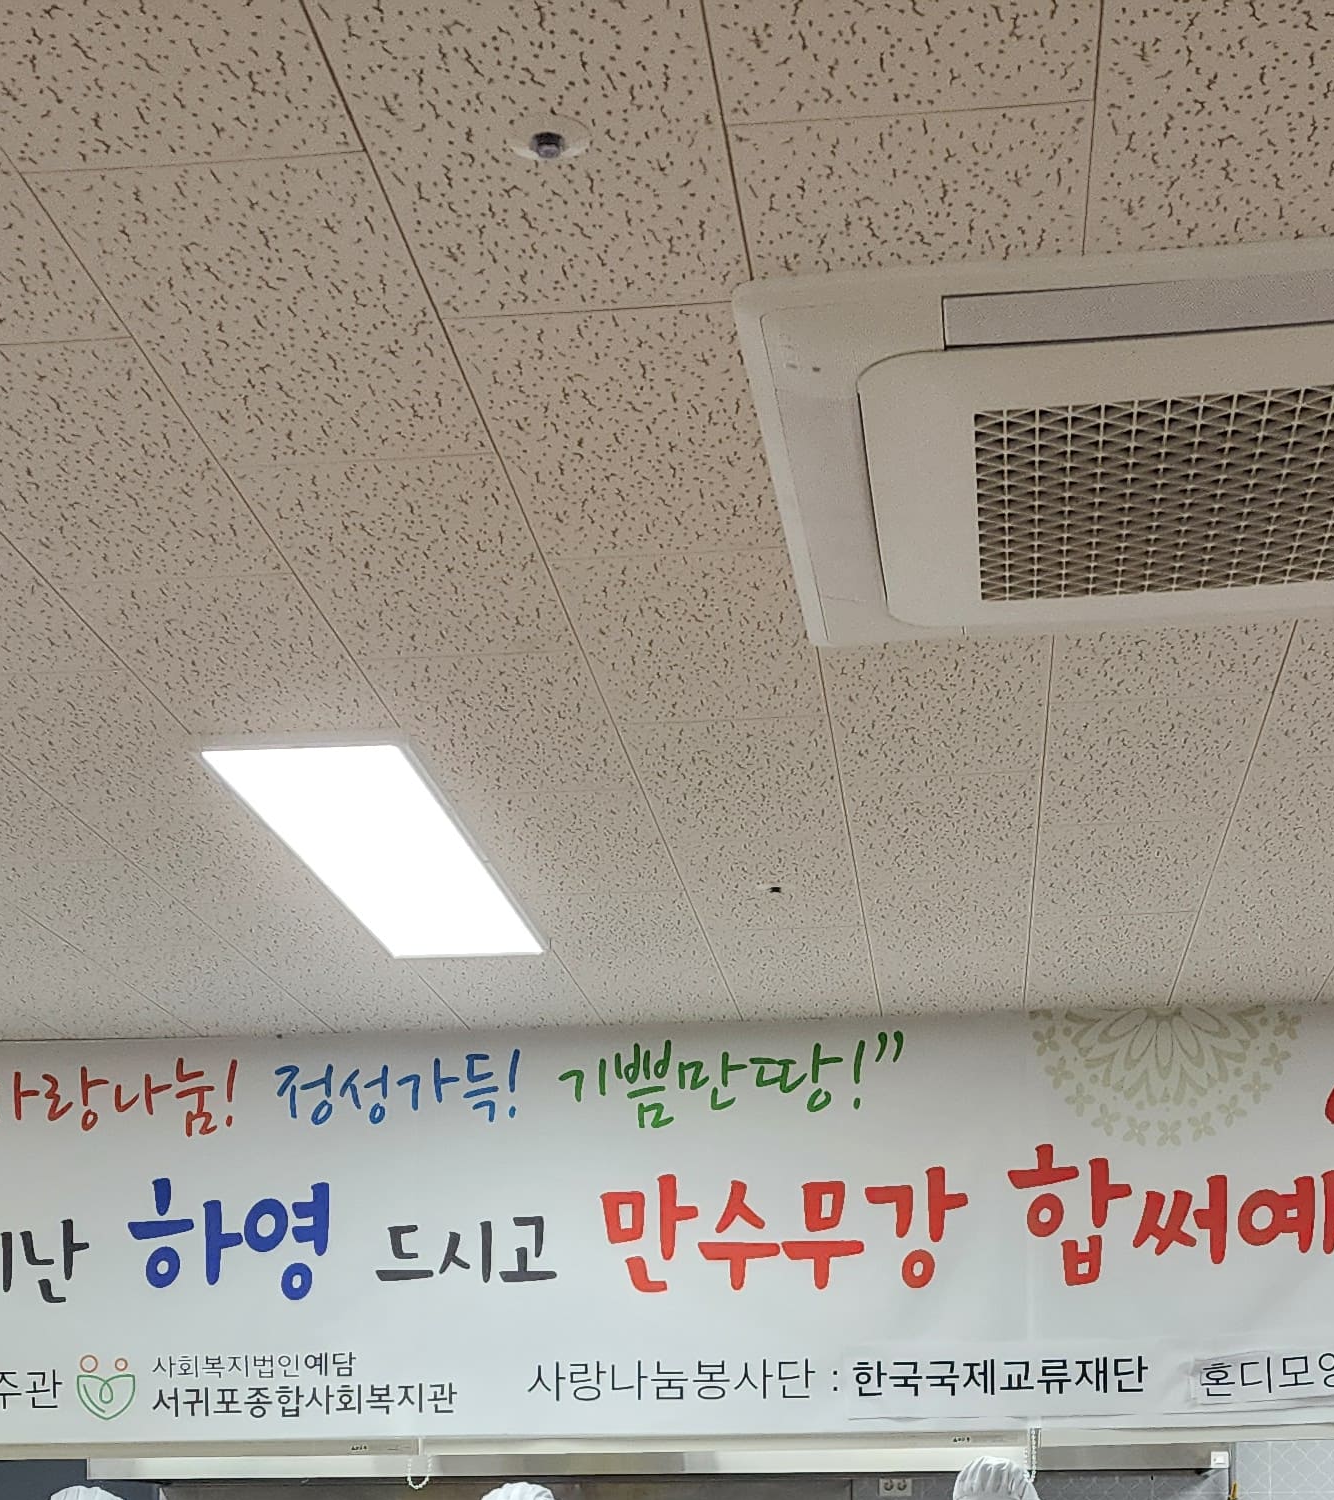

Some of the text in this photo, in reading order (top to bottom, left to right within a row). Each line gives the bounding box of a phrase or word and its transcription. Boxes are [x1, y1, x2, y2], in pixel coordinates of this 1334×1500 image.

[275, 1049, 520, 1125] 정성가득!
[128, 1178, 329, 1300] 하영
[376, 1216, 557, 1283] 드시고
[600, 1166, 968, 1292] 만수무강
[153, 1352, 356, 1378] 사회복지법인예담
[528, 1359, 815, 1401] 사랑나눔봉사단
[853, 1356, 1148, 1396] 한국국제교류재단
[153, 1383, 457, 1418] 서귀포종합사회복지관
